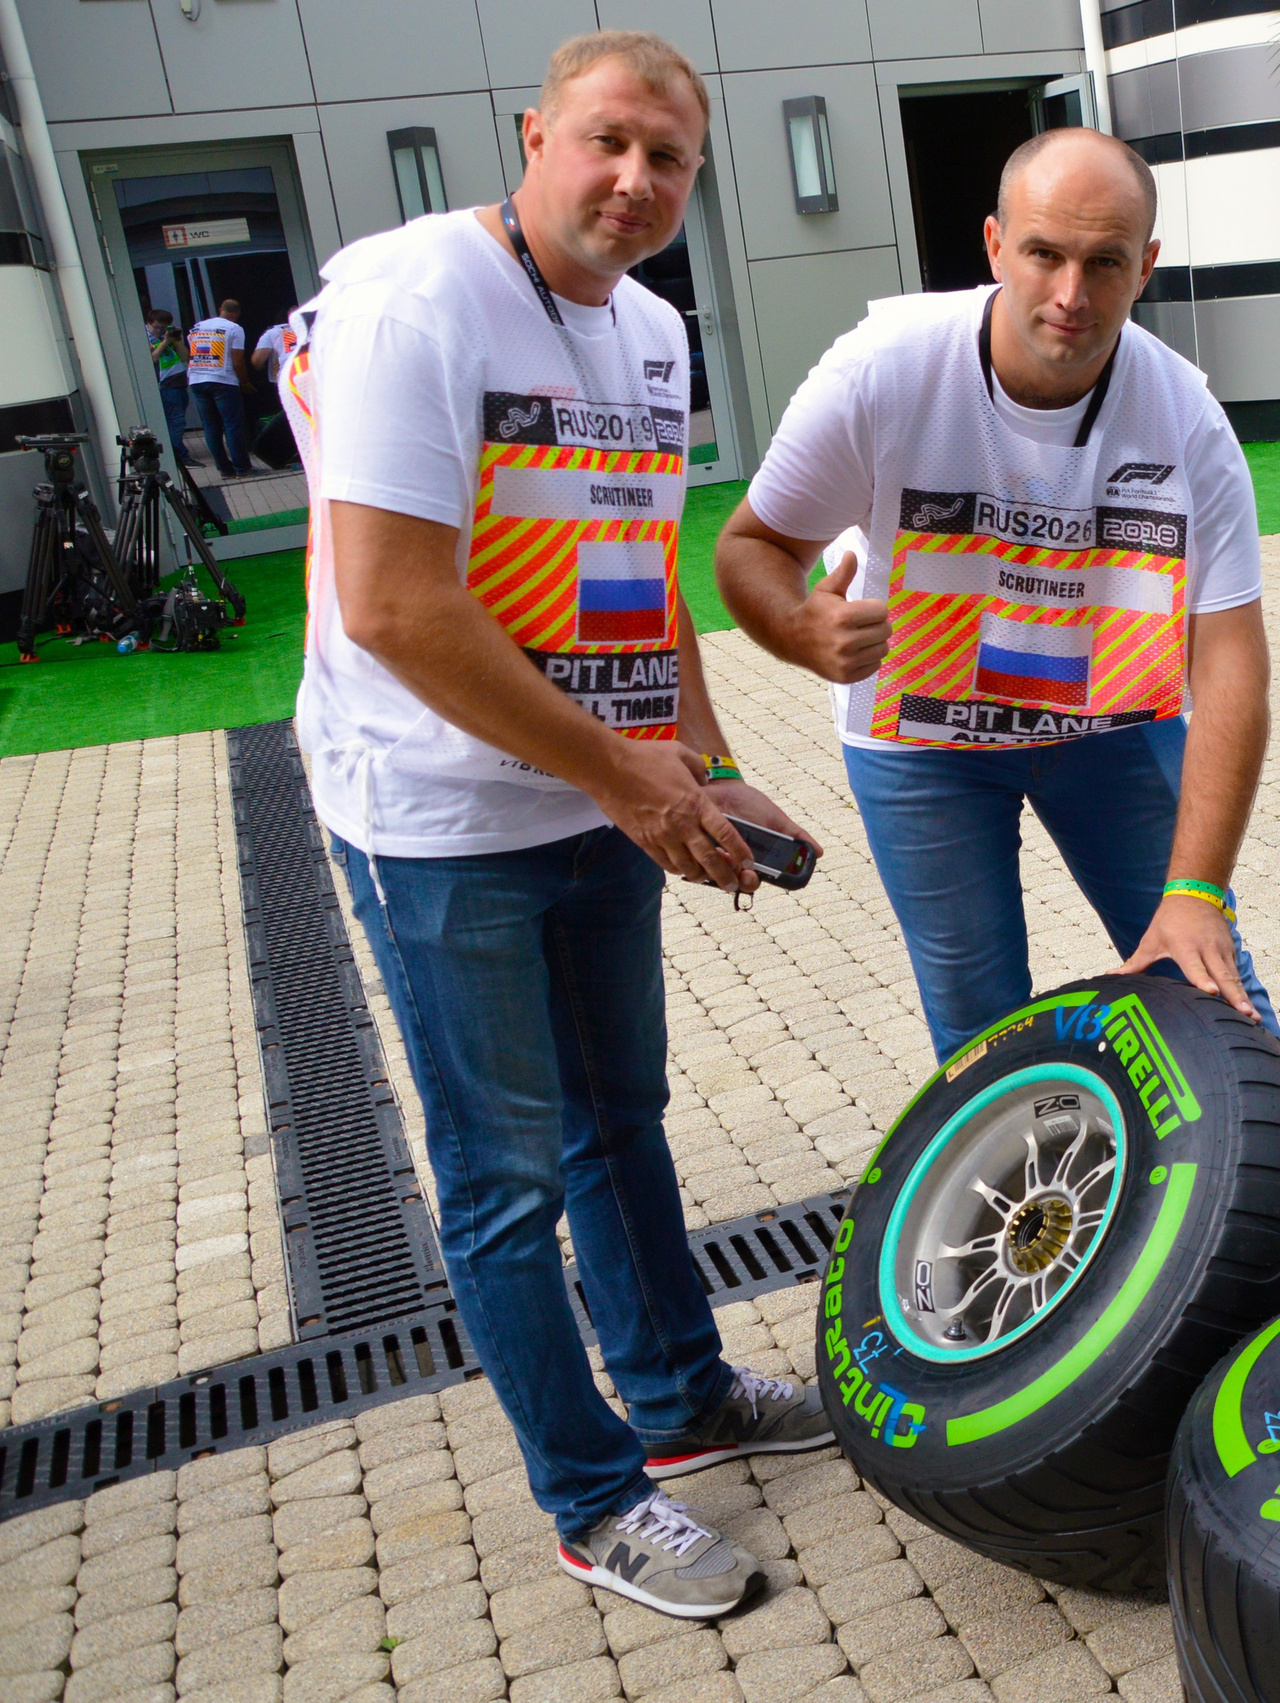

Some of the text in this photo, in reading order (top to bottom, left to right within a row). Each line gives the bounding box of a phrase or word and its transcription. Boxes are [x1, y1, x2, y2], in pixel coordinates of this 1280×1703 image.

[190, 230, 210, 239] WC
[520, 252, 540, 283] SOCHI
[556, 408, 654, 443] RUS2019
[590, 484, 654, 508] SCRUTINEER
[977, 502, 1092, 544] RUS2026
[998, 570, 1086, 599] SCRUTINEER
[545, 655, 678, 690] PIT LANE
[611, 695, 674, 722] TIMES
[945, 705, 1113, 734] PIT LANE
[1095, 993, 1201, 1140] PIRELLI
[825, 1218, 926, 1449] Cinturato
[605, 1541, 650, 1583] N
